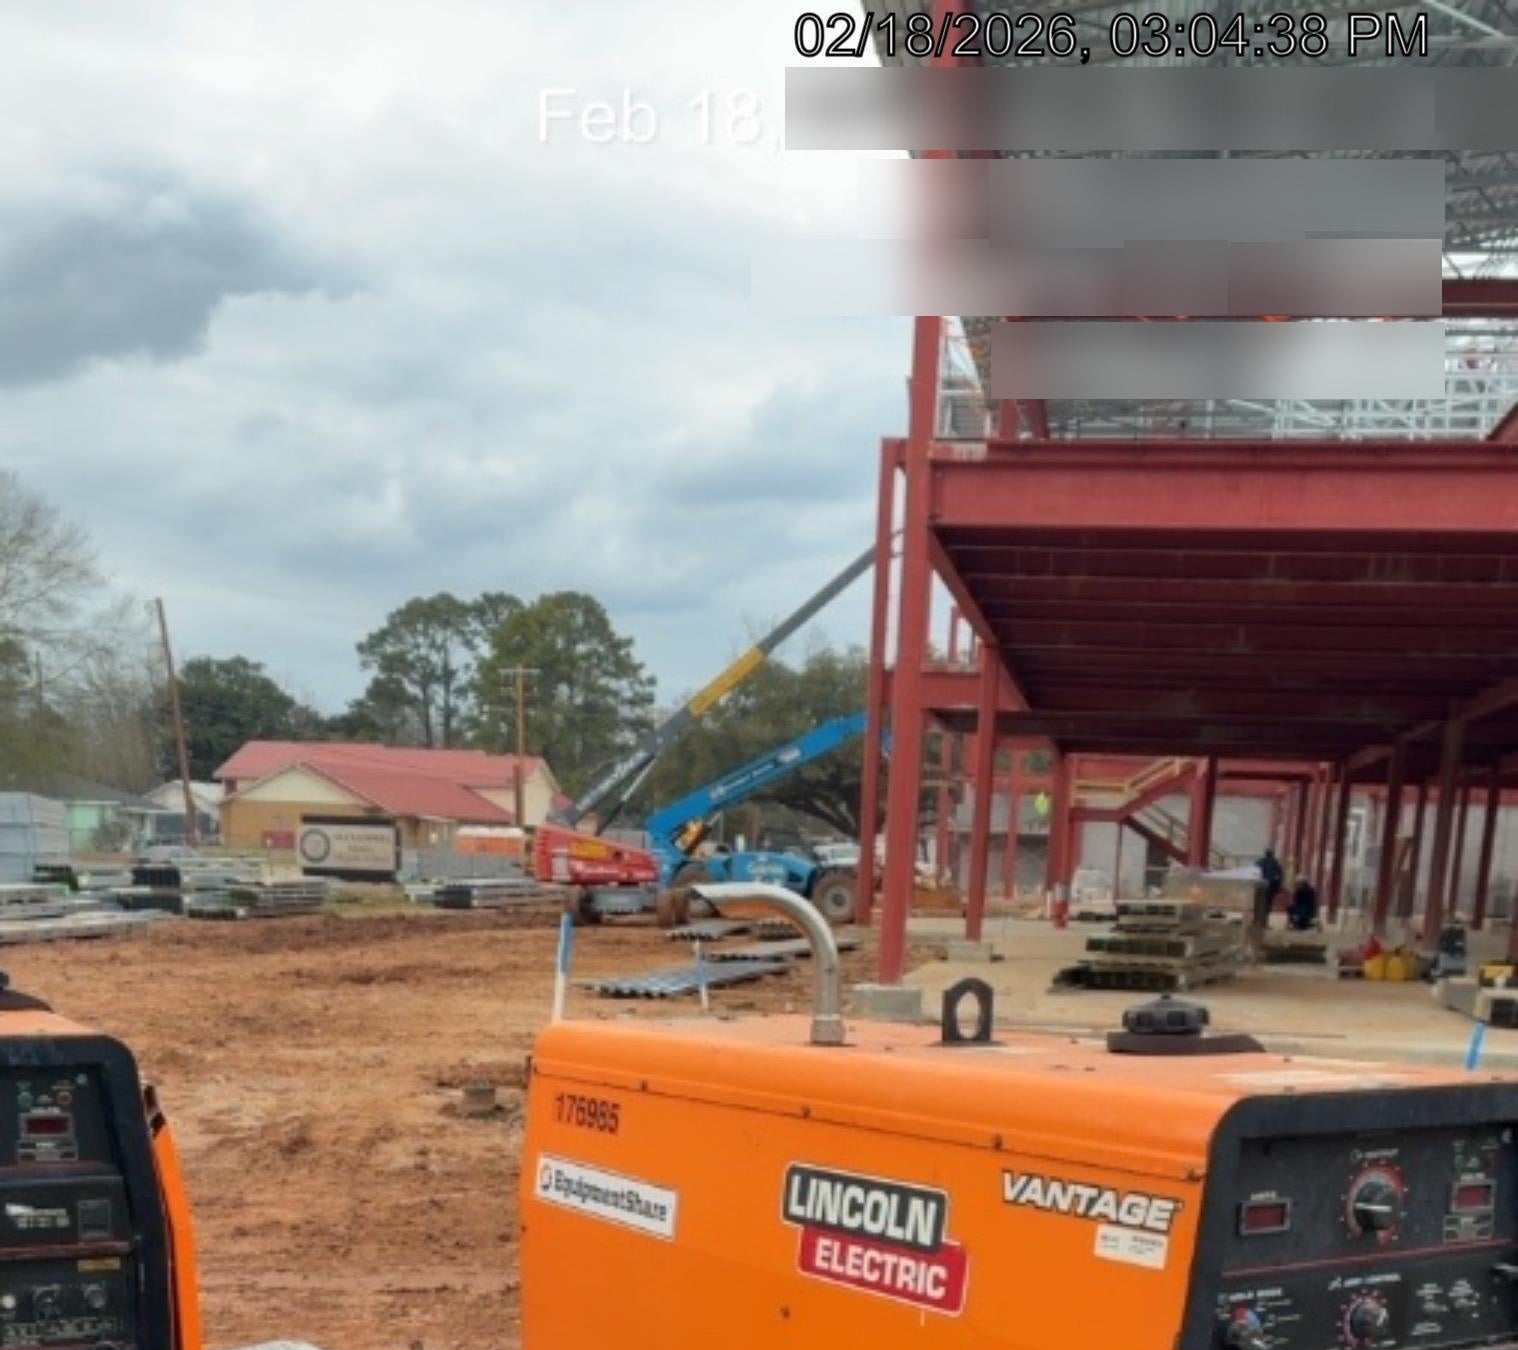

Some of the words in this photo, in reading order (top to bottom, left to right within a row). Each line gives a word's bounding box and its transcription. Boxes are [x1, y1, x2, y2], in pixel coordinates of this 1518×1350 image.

[555, 1093, 620, 1135] 176985
[554, 1168, 667, 1222] EquipmentShare
[787, 1174, 938, 1247] LINCOLN
[1002, 1171, 1175, 1232] VANTAGE
[814, 1237, 948, 1300] ELECTRIC
